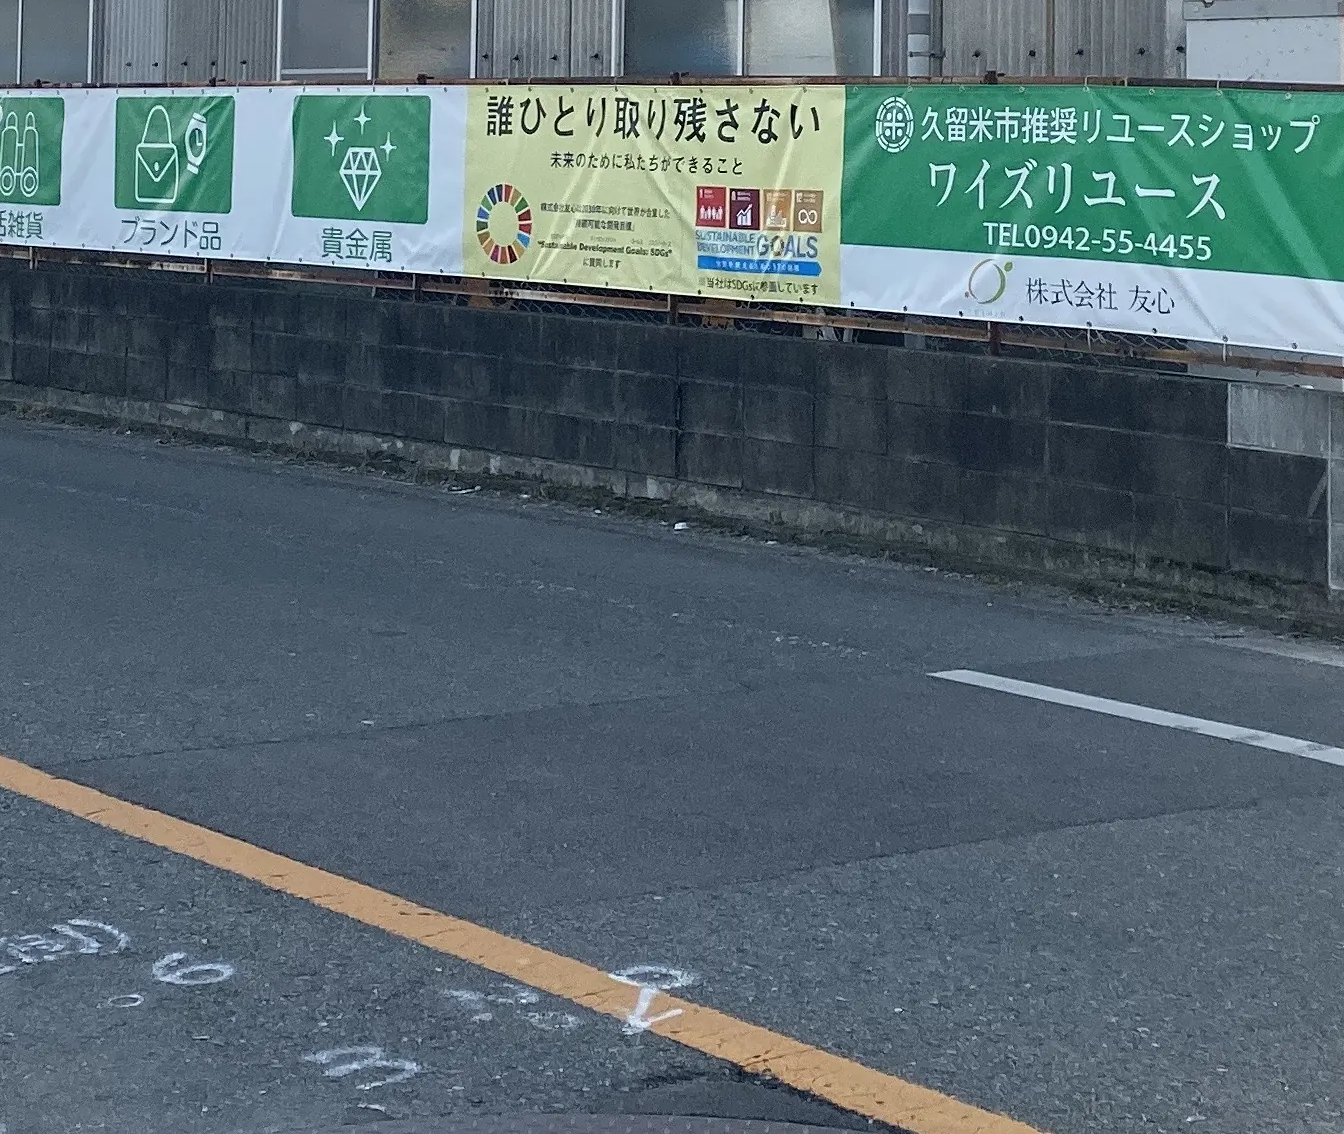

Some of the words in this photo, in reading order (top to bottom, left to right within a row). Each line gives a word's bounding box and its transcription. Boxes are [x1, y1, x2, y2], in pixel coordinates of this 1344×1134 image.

[486, 95, 821, 145] 誰ひとり取り残さない
[920, 105, 1321, 155] 久留米市推奨リユースショップ
[549, 150, 744, 176] 未来のために私たちができること
[927, 157, 1227, 221] ワイズリユース
[121, 216, 222, 251] ブランド品
[321, 227, 393, 263] 貴金属
[696, 230, 756, 243] SUSTAINABLE
[697, 242, 755, 255] DEVELOPMENT
[757, 234, 818, 258] GOALS
[982, 221, 1212, 261] TEL0942-55-4455
[1026, 277, 1119, 311] 株式会社
[1128, 284, 1176, 315] 友心
[153, 951, 236, 986] 6
